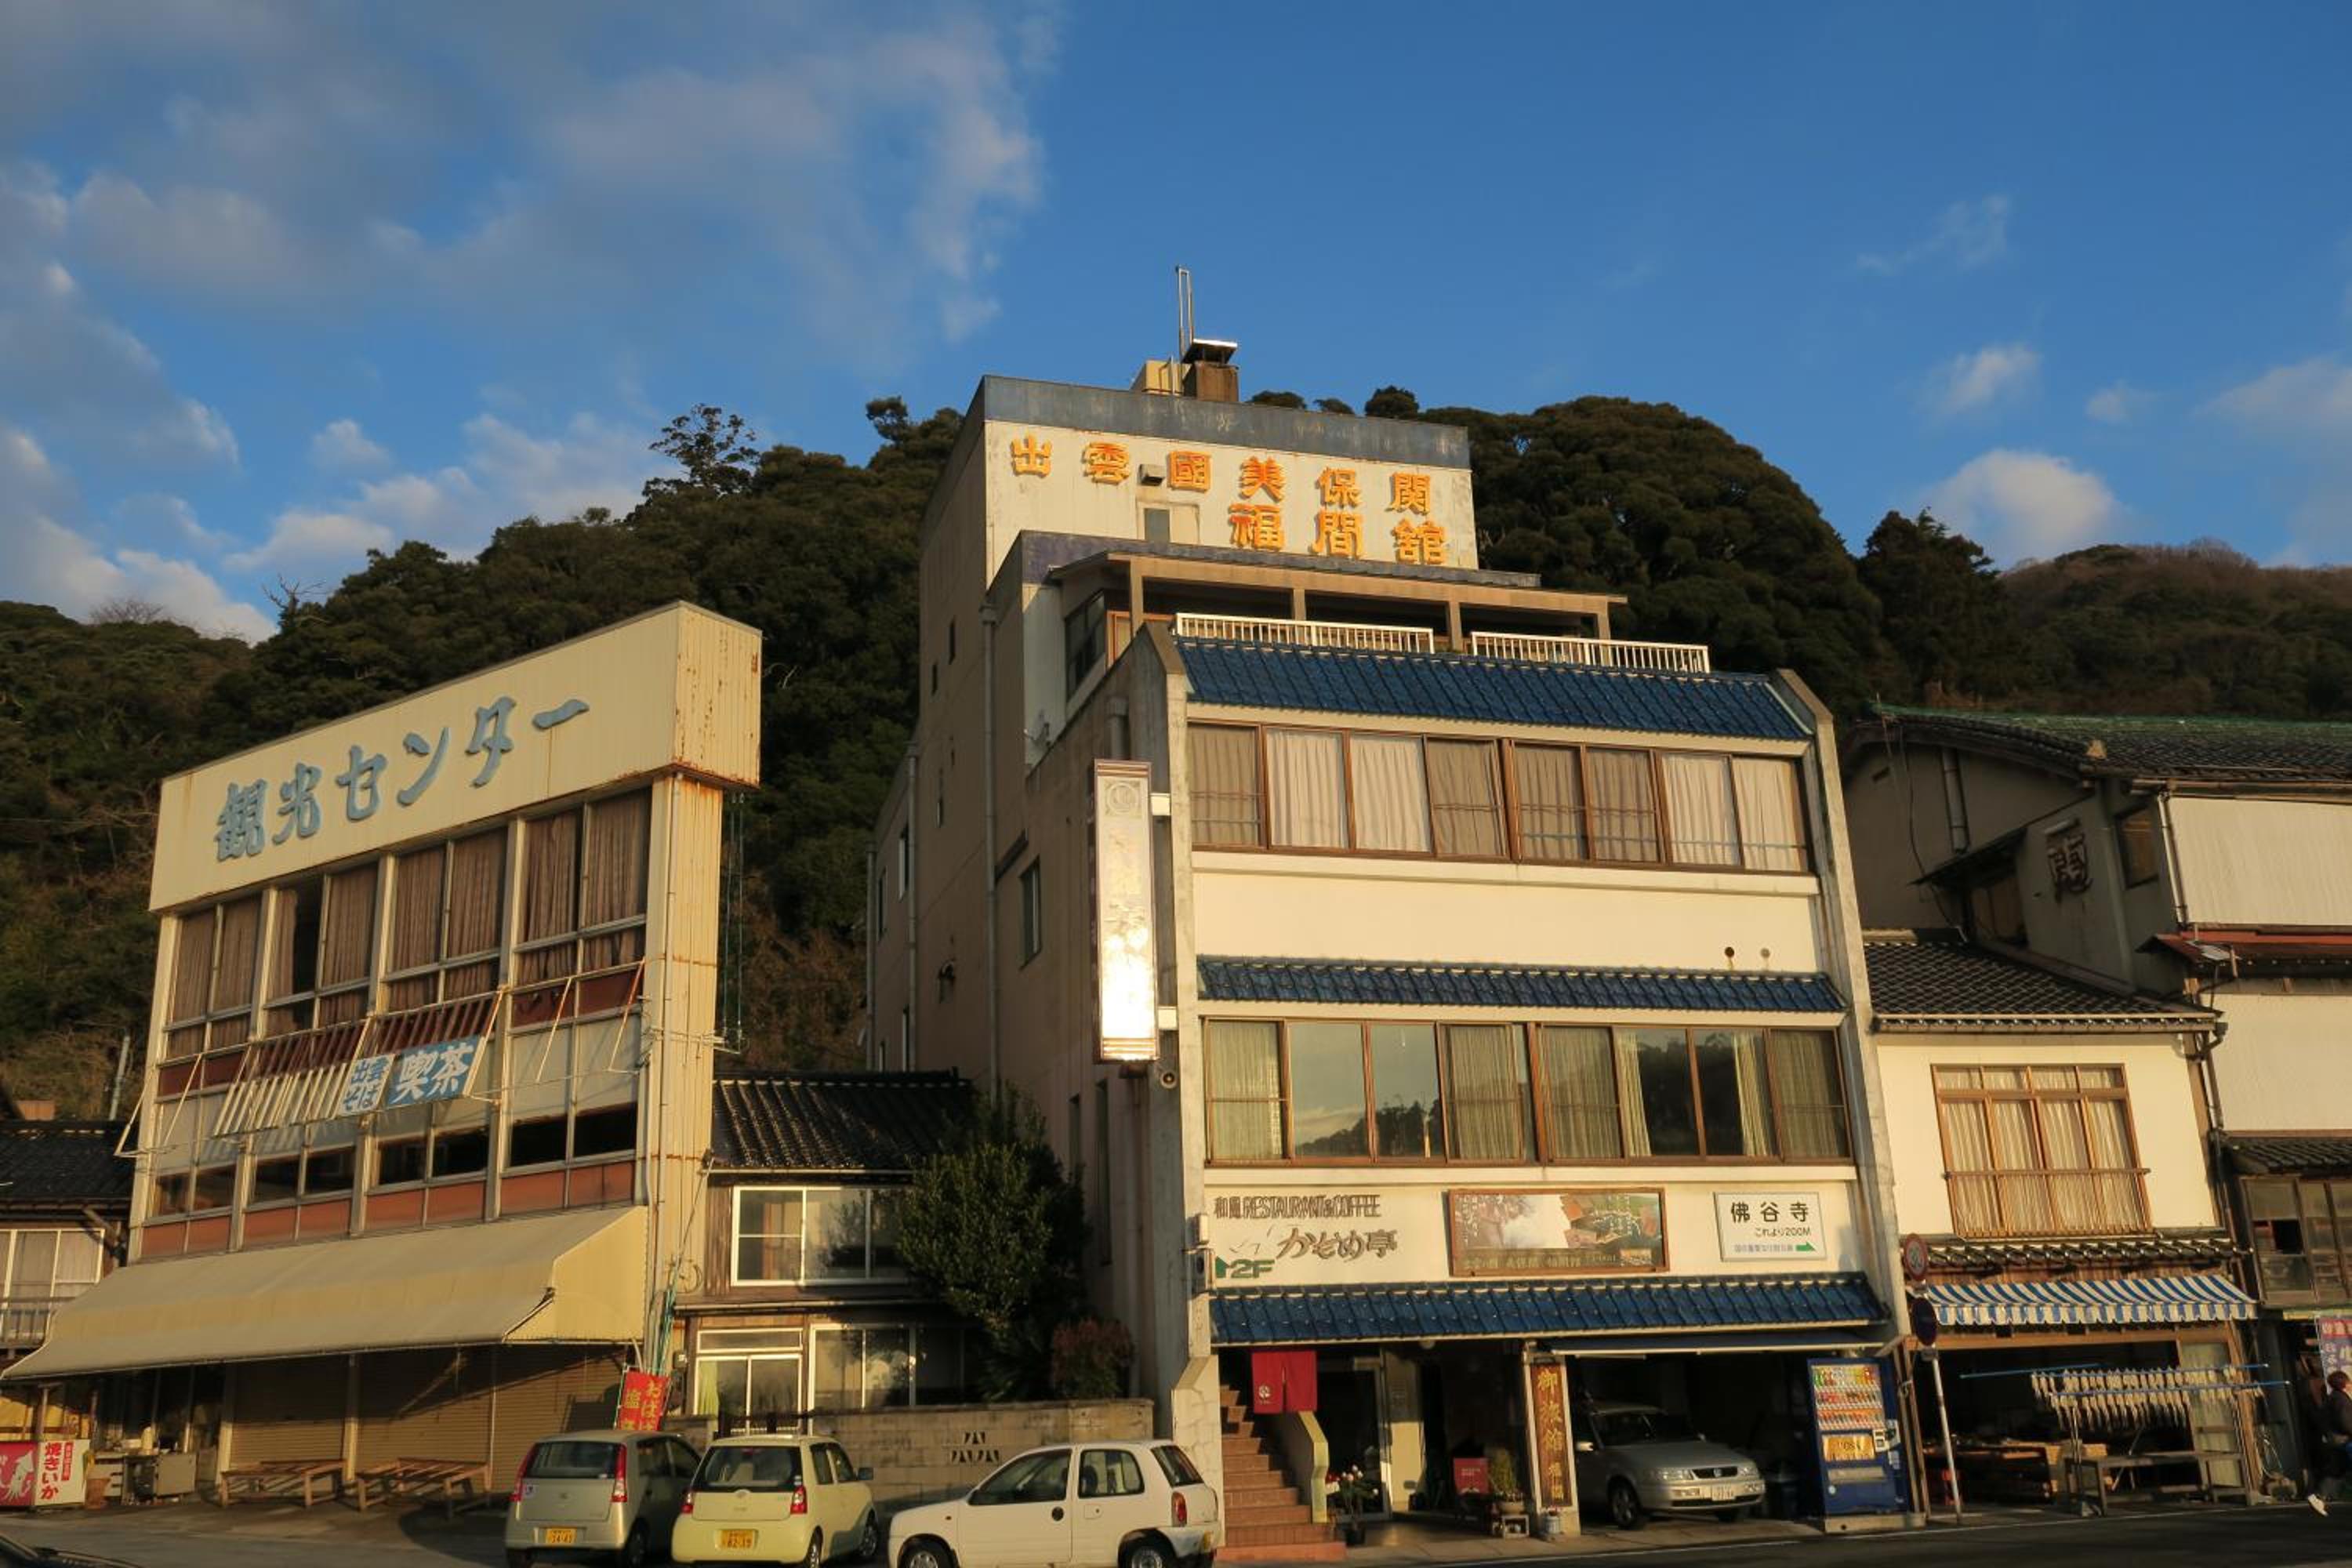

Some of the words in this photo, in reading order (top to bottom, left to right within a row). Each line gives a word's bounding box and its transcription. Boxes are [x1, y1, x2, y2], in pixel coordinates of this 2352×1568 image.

[213, 695, 590, 861] 観光センター
[391, 1042, 474, 1104] 喫茶
[1730, 1202, 1809, 1223] 佛谷寺
[1276, 1227, 1398, 1261] かもめ亭
[1230, 1259, 1275, 1279] 2F
[41, 1442, 62, 1500] 焼きいか
